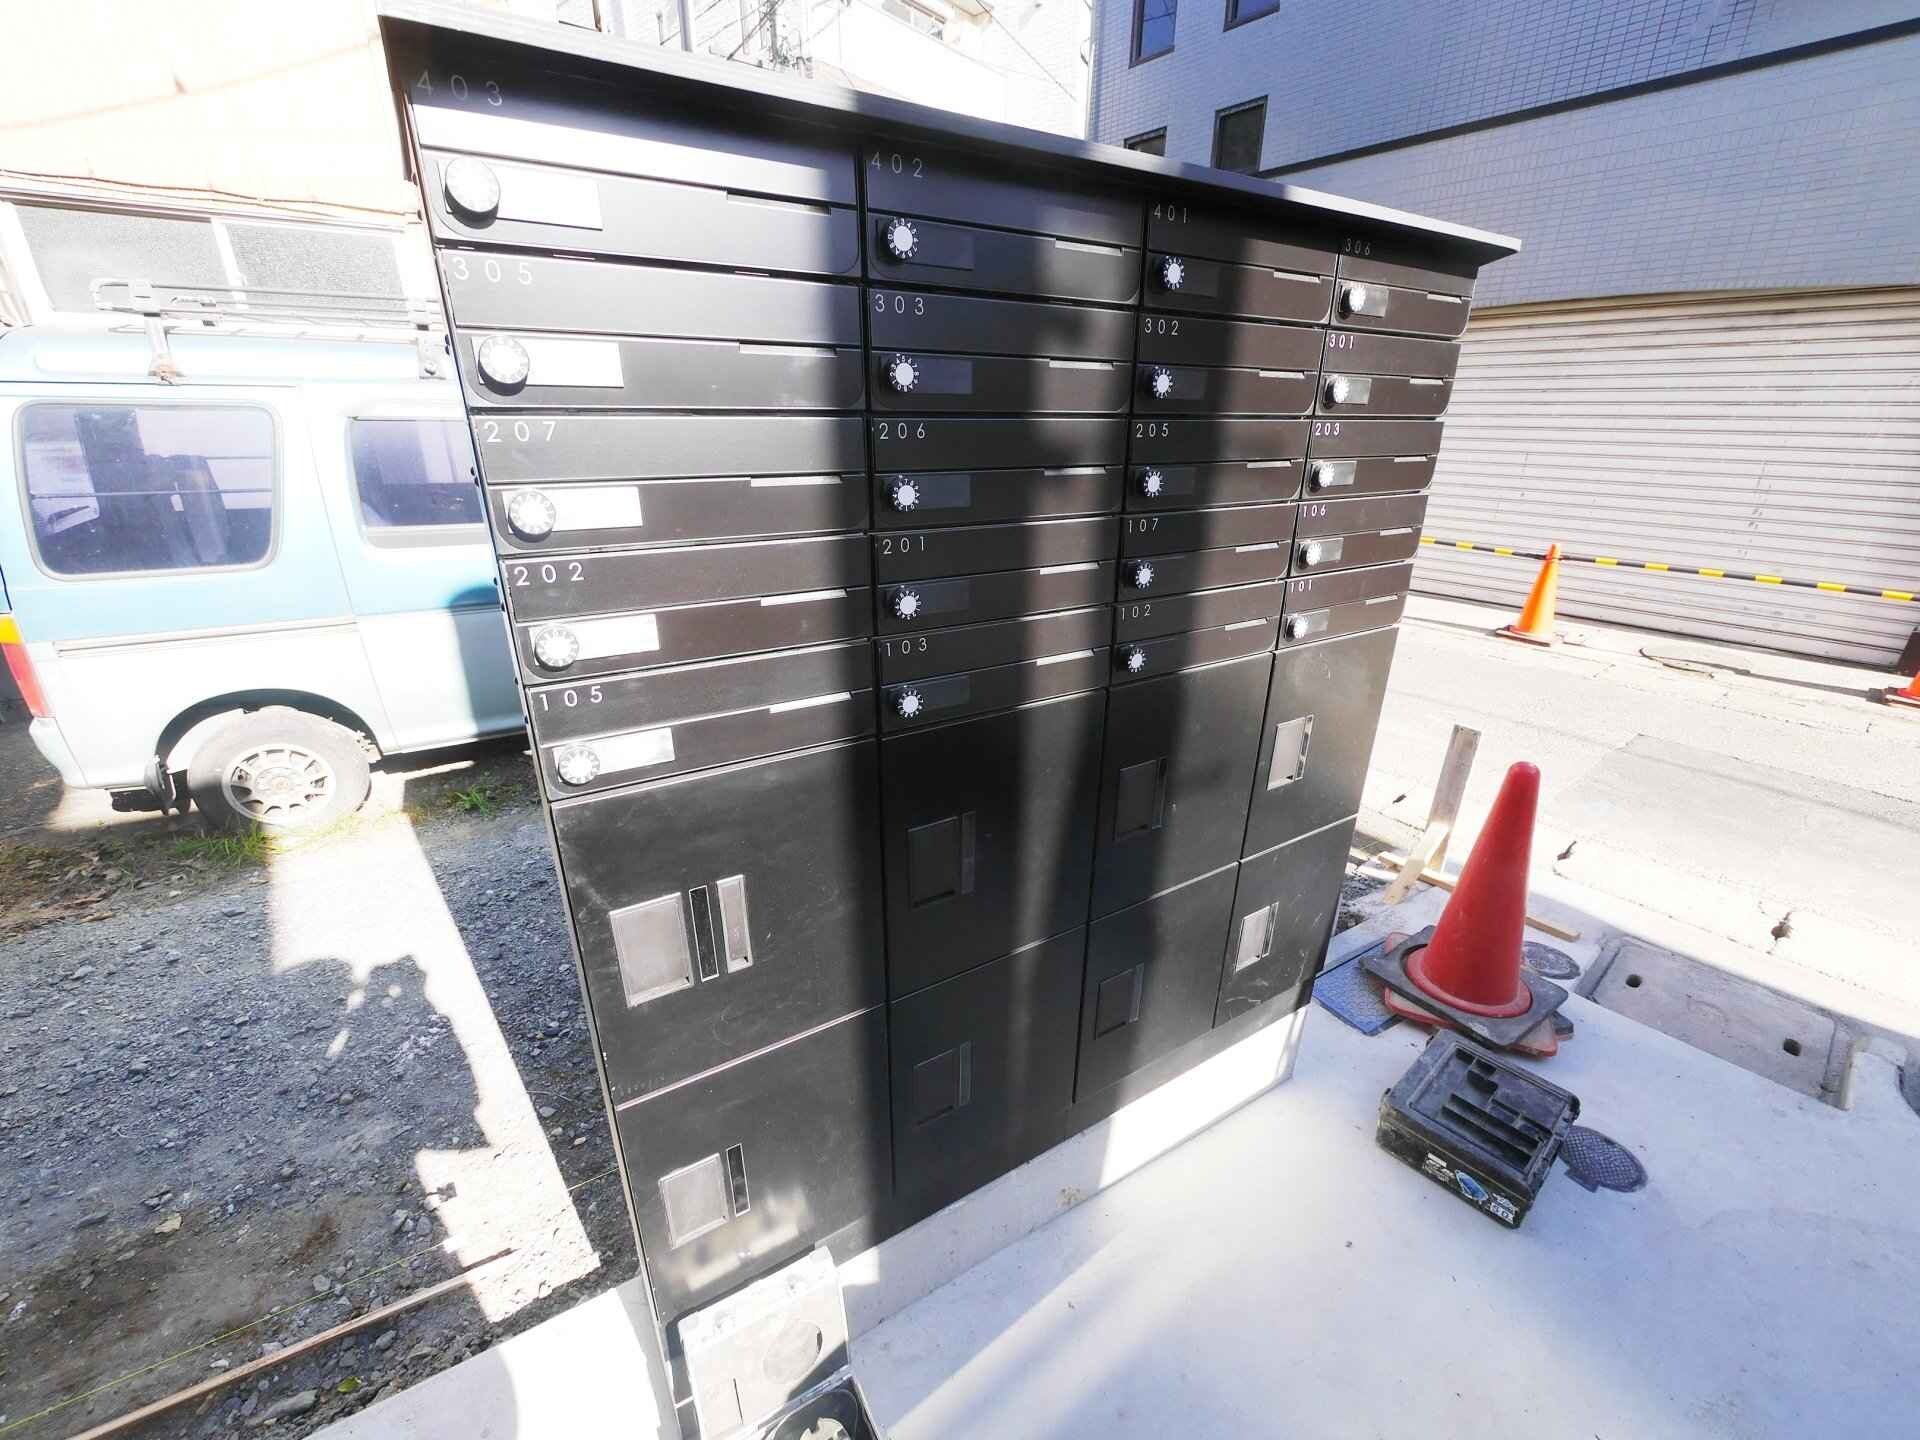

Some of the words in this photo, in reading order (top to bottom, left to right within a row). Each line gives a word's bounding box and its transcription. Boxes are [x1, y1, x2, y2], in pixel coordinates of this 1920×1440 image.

[417, 71, 503, 106] 403
[871, 151, 923, 178] 402
[1154, 204, 1188, 224] 401
[1345, 238, 1371, 256] 306
[453, 257, 533, 285] 305
[875, 294, 924, 316] 303
[1144, 318, 1179, 336] 302
[1329, 334, 1354, 349] 301
[484, 420, 557, 443] 207
[879, 422, 926, 440] 206
[1136, 423, 1169, 438] 205
[1315, 423, 1341, 436] 203
[1303, 504, 1327, 518] 106
[1128, 517, 1159, 534] 107
[882, 536, 924, 555] 201
[514, 562, 584, 586] 202
[1291, 579, 1313, 592] 101
[1121, 604, 1151, 621] 102
[886, 637, 927, 657] 103
[539, 685, 603, 711] 105
